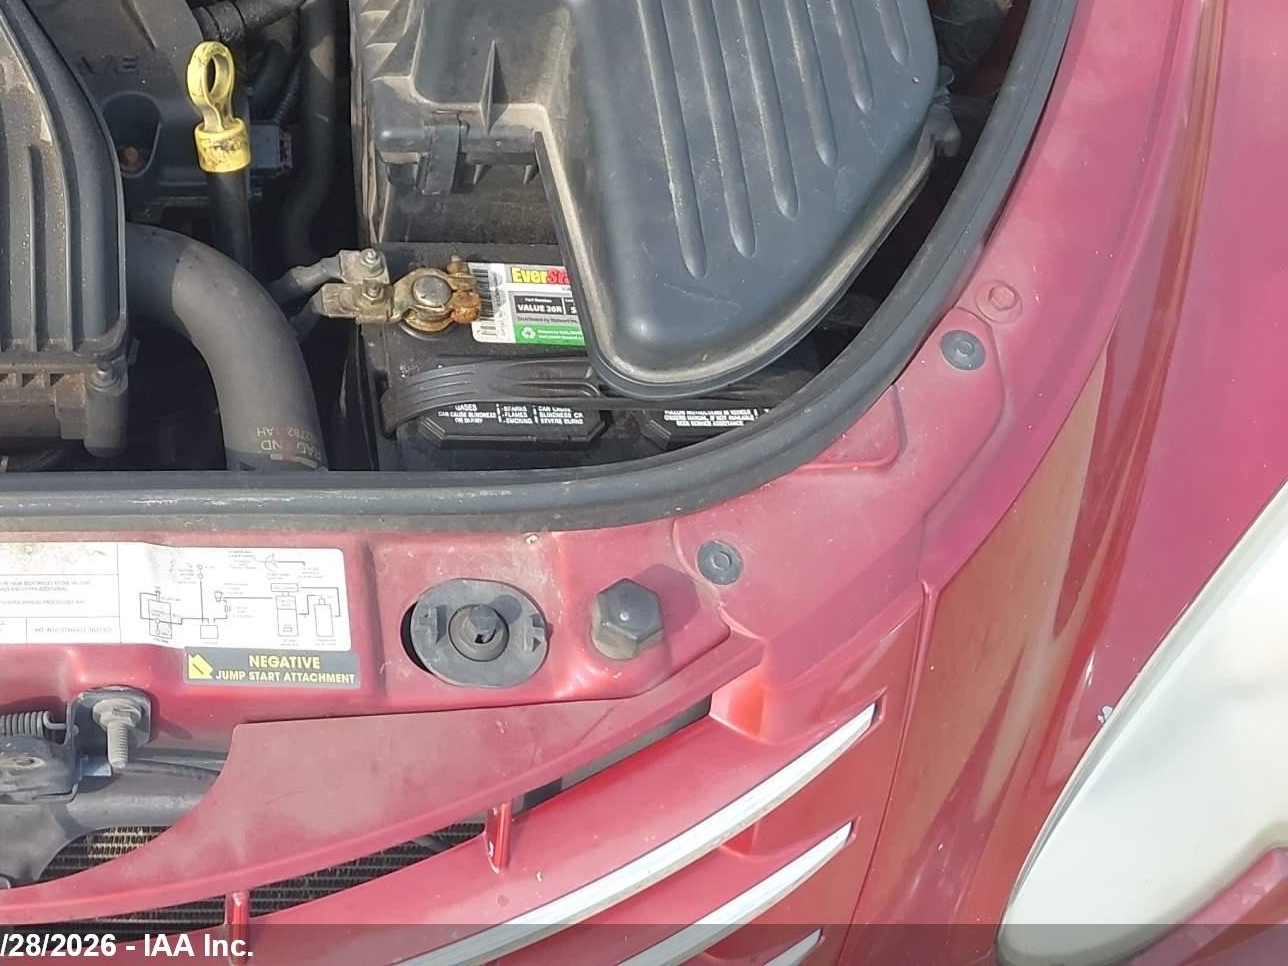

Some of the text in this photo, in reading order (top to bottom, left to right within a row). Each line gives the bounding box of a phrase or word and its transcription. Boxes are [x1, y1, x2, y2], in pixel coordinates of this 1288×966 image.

[517, 304, 545, 312] VALUE
[248, 655, 321, 670] NEGATIVE
[215, 670, 356, 684] JUMP START ATTACHMENT
